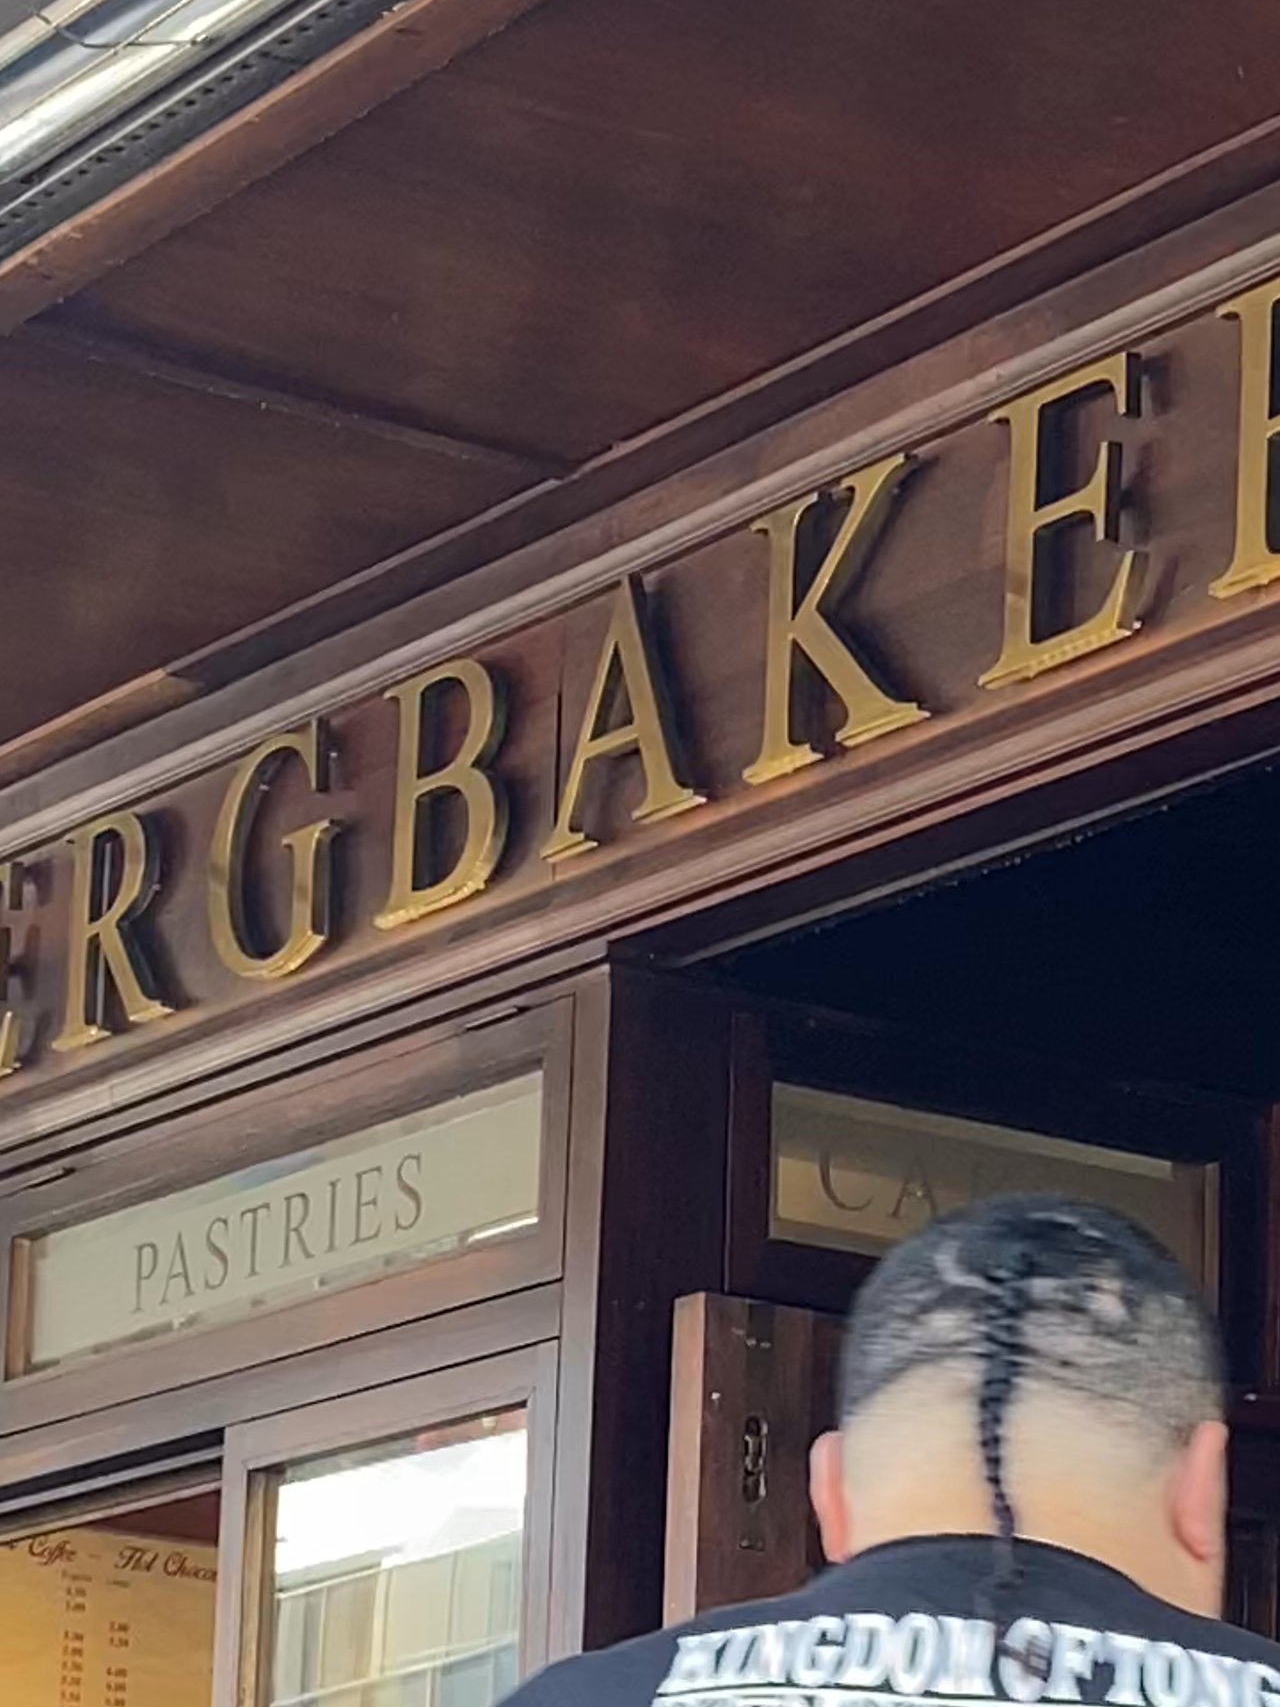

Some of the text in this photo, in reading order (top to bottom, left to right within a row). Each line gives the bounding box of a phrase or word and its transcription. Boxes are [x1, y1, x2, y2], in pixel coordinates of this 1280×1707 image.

[131, 1152, 425, 1314] PASTRIES
[28, 1536, 77, 1567] Coffee
[657, 1613, 996, 1695] KINGDOM
[996, 1617, 1098, 1702] OF
